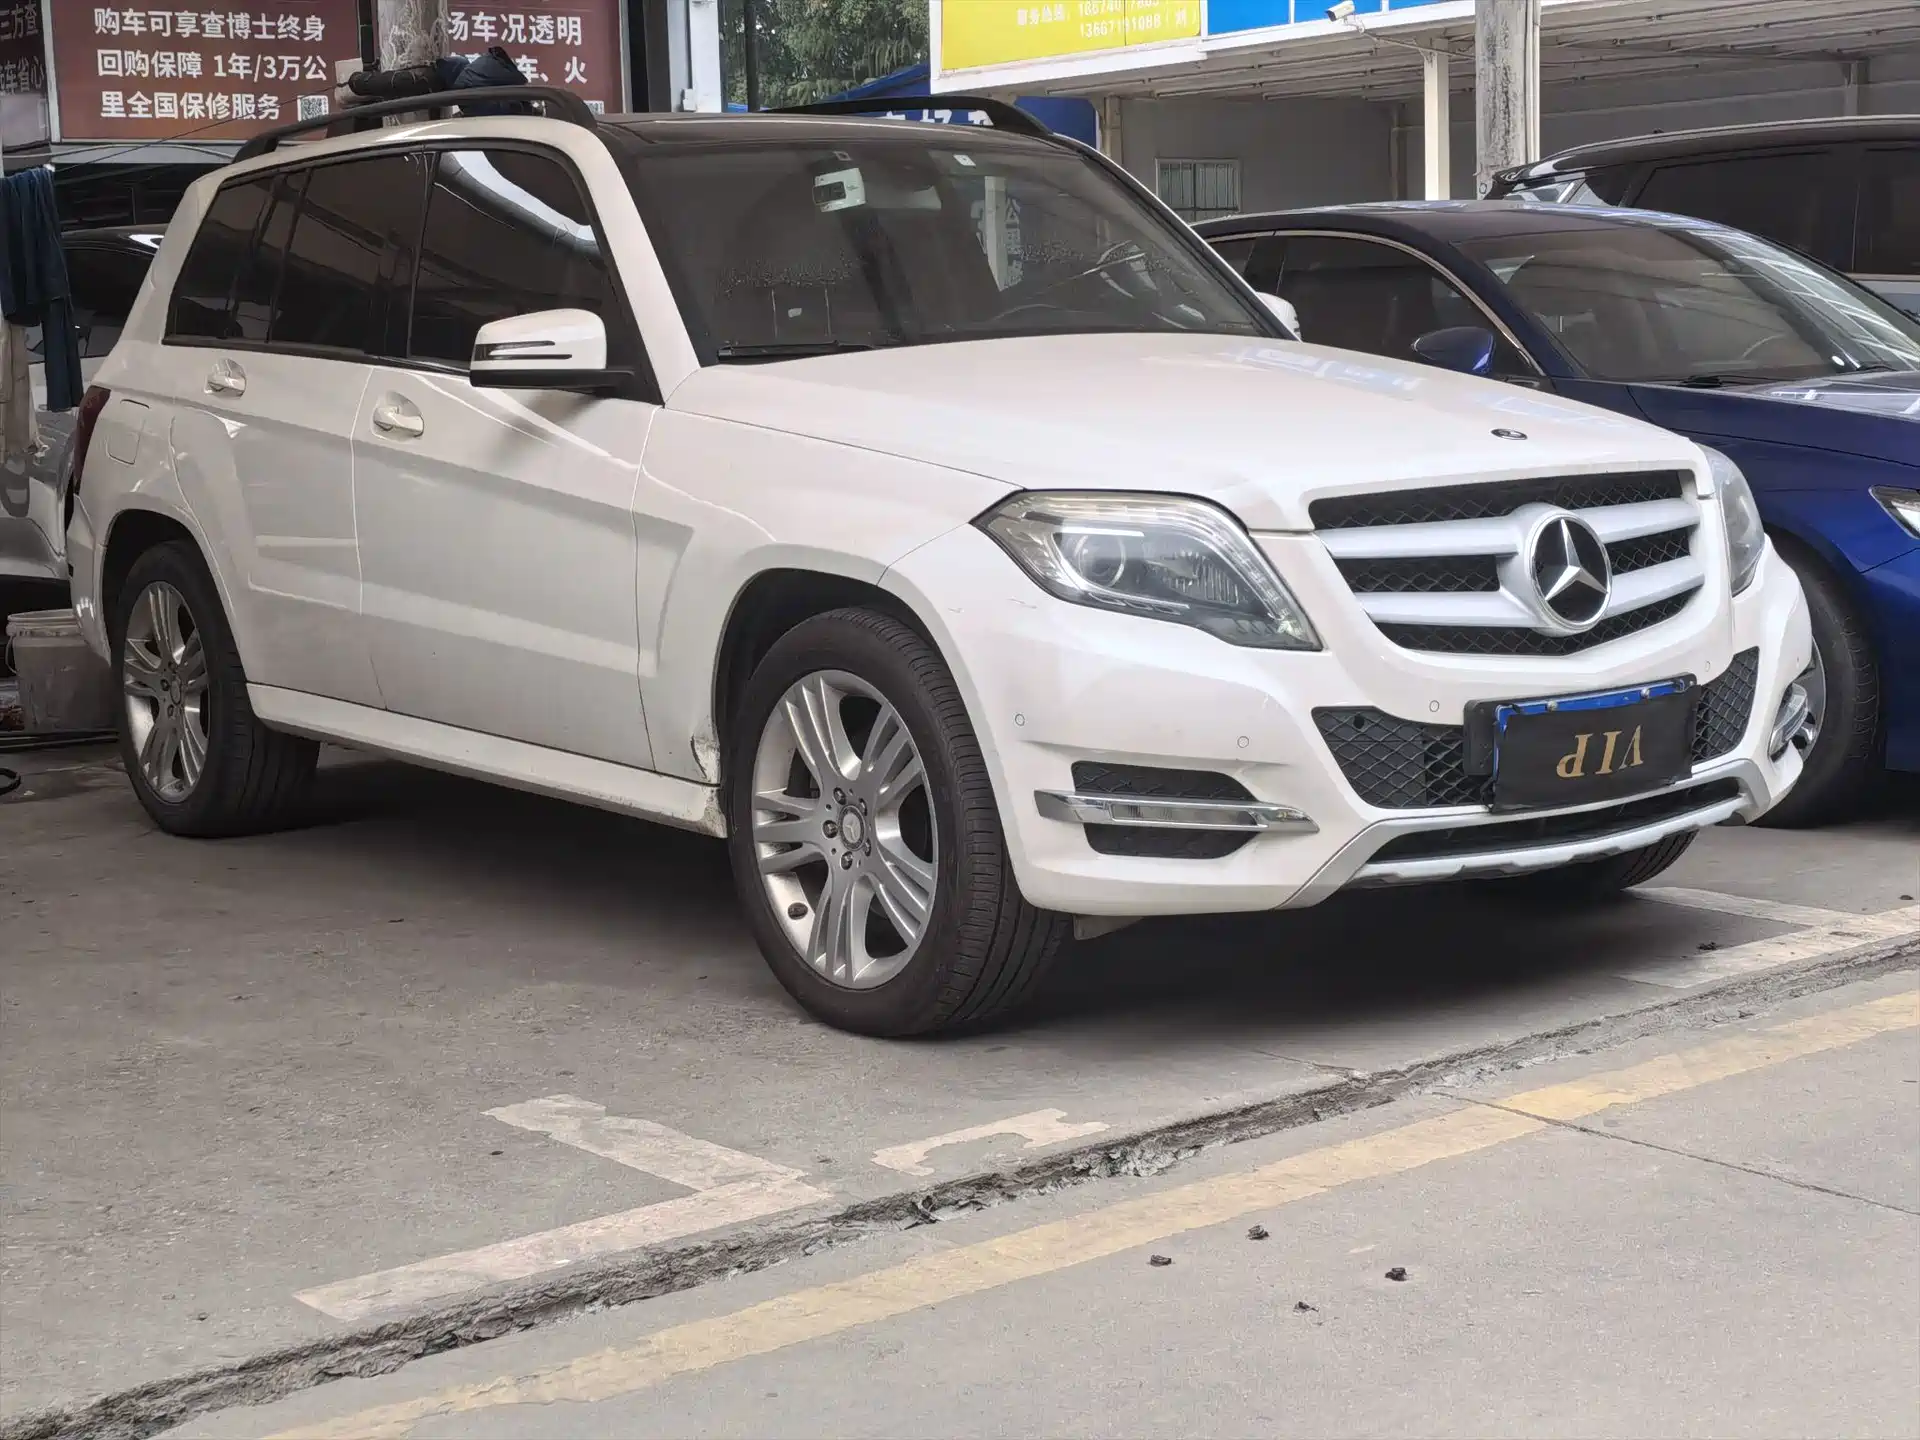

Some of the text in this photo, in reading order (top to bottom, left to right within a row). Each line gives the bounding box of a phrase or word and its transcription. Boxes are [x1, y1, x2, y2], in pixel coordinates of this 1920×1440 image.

[94, 8, 325, 42] 购车可享查博士终身
[97, 49, 328, 83] 回购保障 1年/3万公
[101, 91, 281, 120] 里全国保修服务
[1556, 724, 1644, 778] VIP
